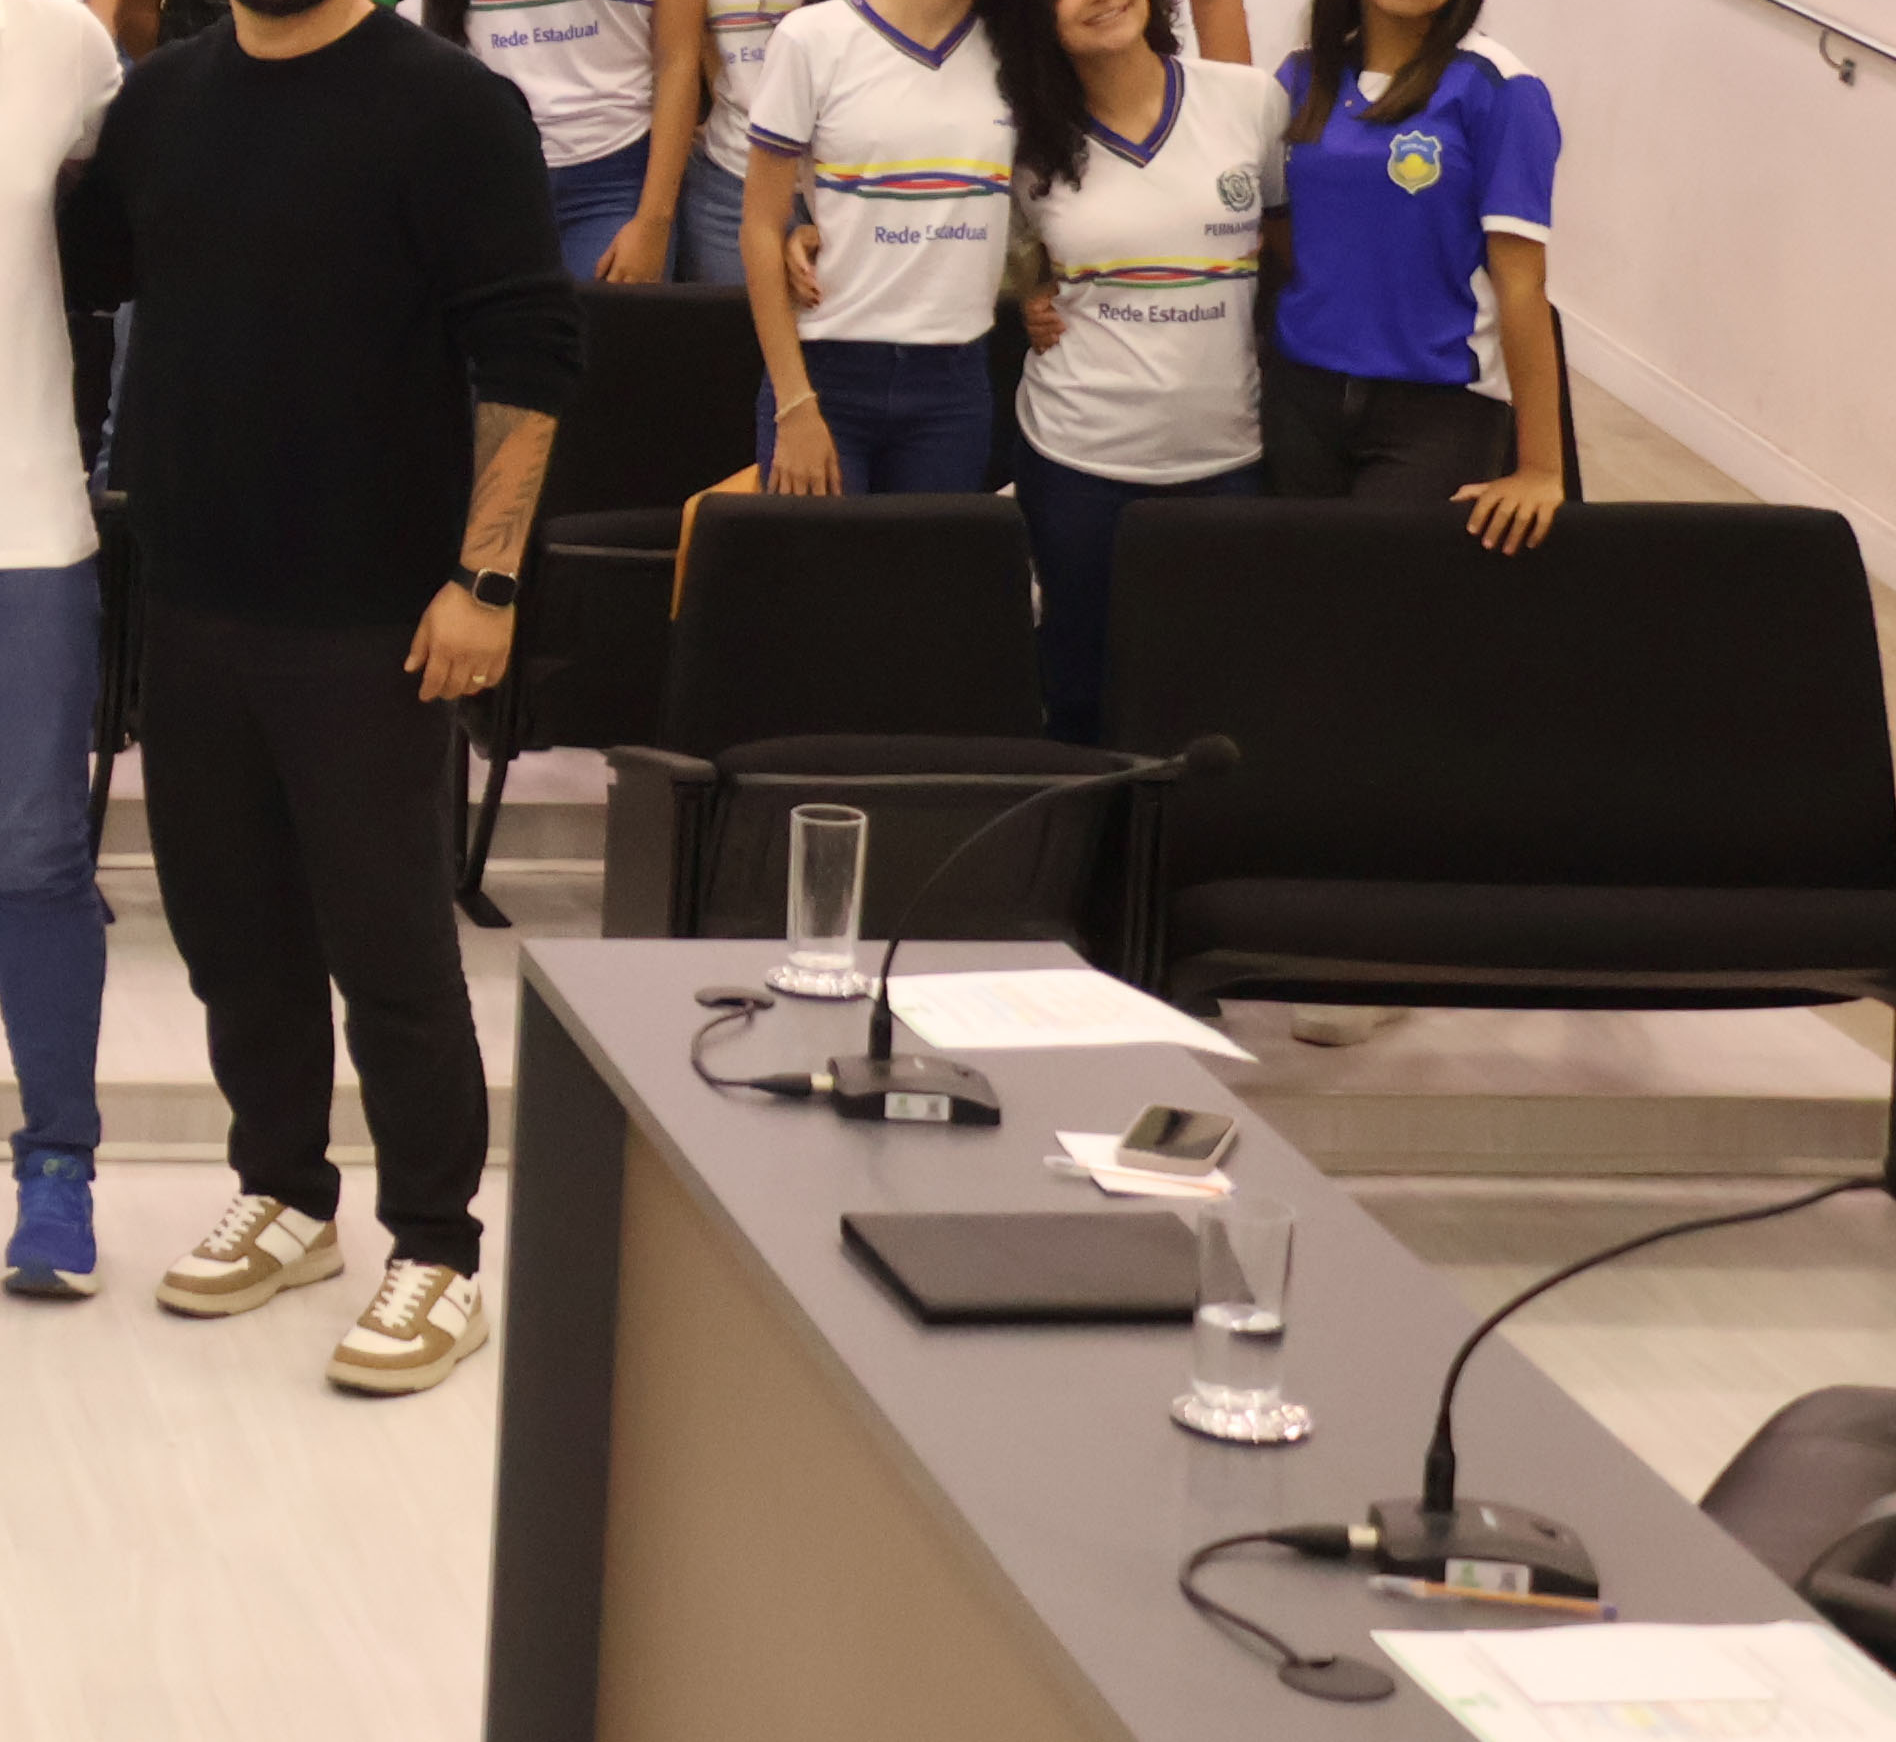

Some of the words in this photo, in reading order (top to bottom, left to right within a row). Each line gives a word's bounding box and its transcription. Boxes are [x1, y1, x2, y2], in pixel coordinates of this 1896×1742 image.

[491, 30, 529, 50] Rede
[533, 20, 599, 43] Estadual
[874, 225, 921, 244] Rede
[1098, 303, 1143, 322] Rede
[1148, 301, 1226, 323] Estadual
